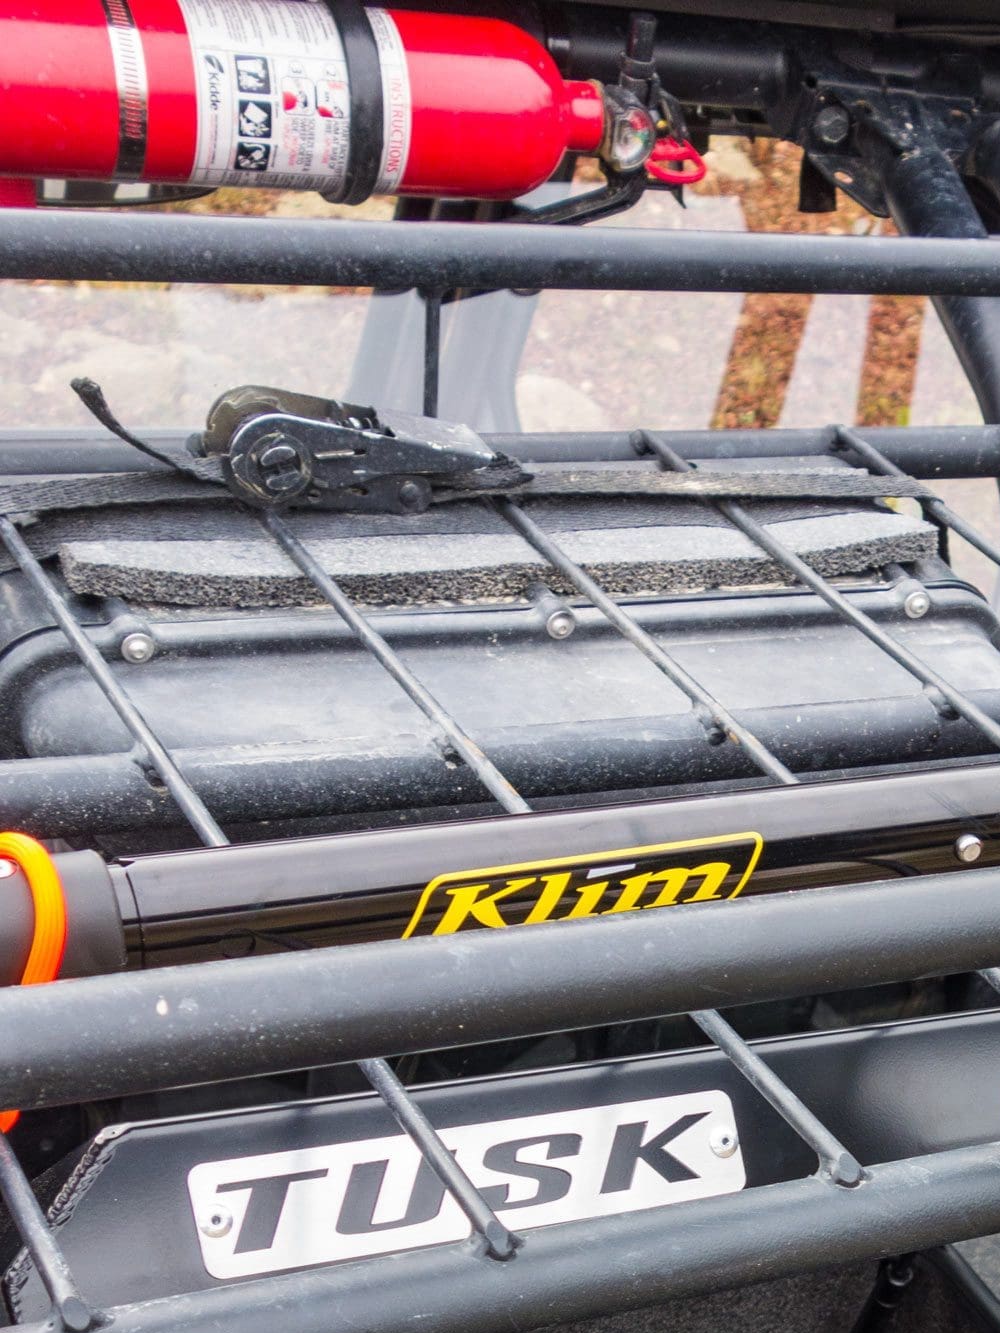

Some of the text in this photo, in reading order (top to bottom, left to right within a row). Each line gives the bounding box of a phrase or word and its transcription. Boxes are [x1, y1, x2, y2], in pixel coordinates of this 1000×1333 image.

[207, 72, 219, 111] Kidde
[387, 76, 404, 174] INSTRUCTIONS
[432, 862, 731, 936] Klim
[215, 1110, 713, 1255] TUSK
